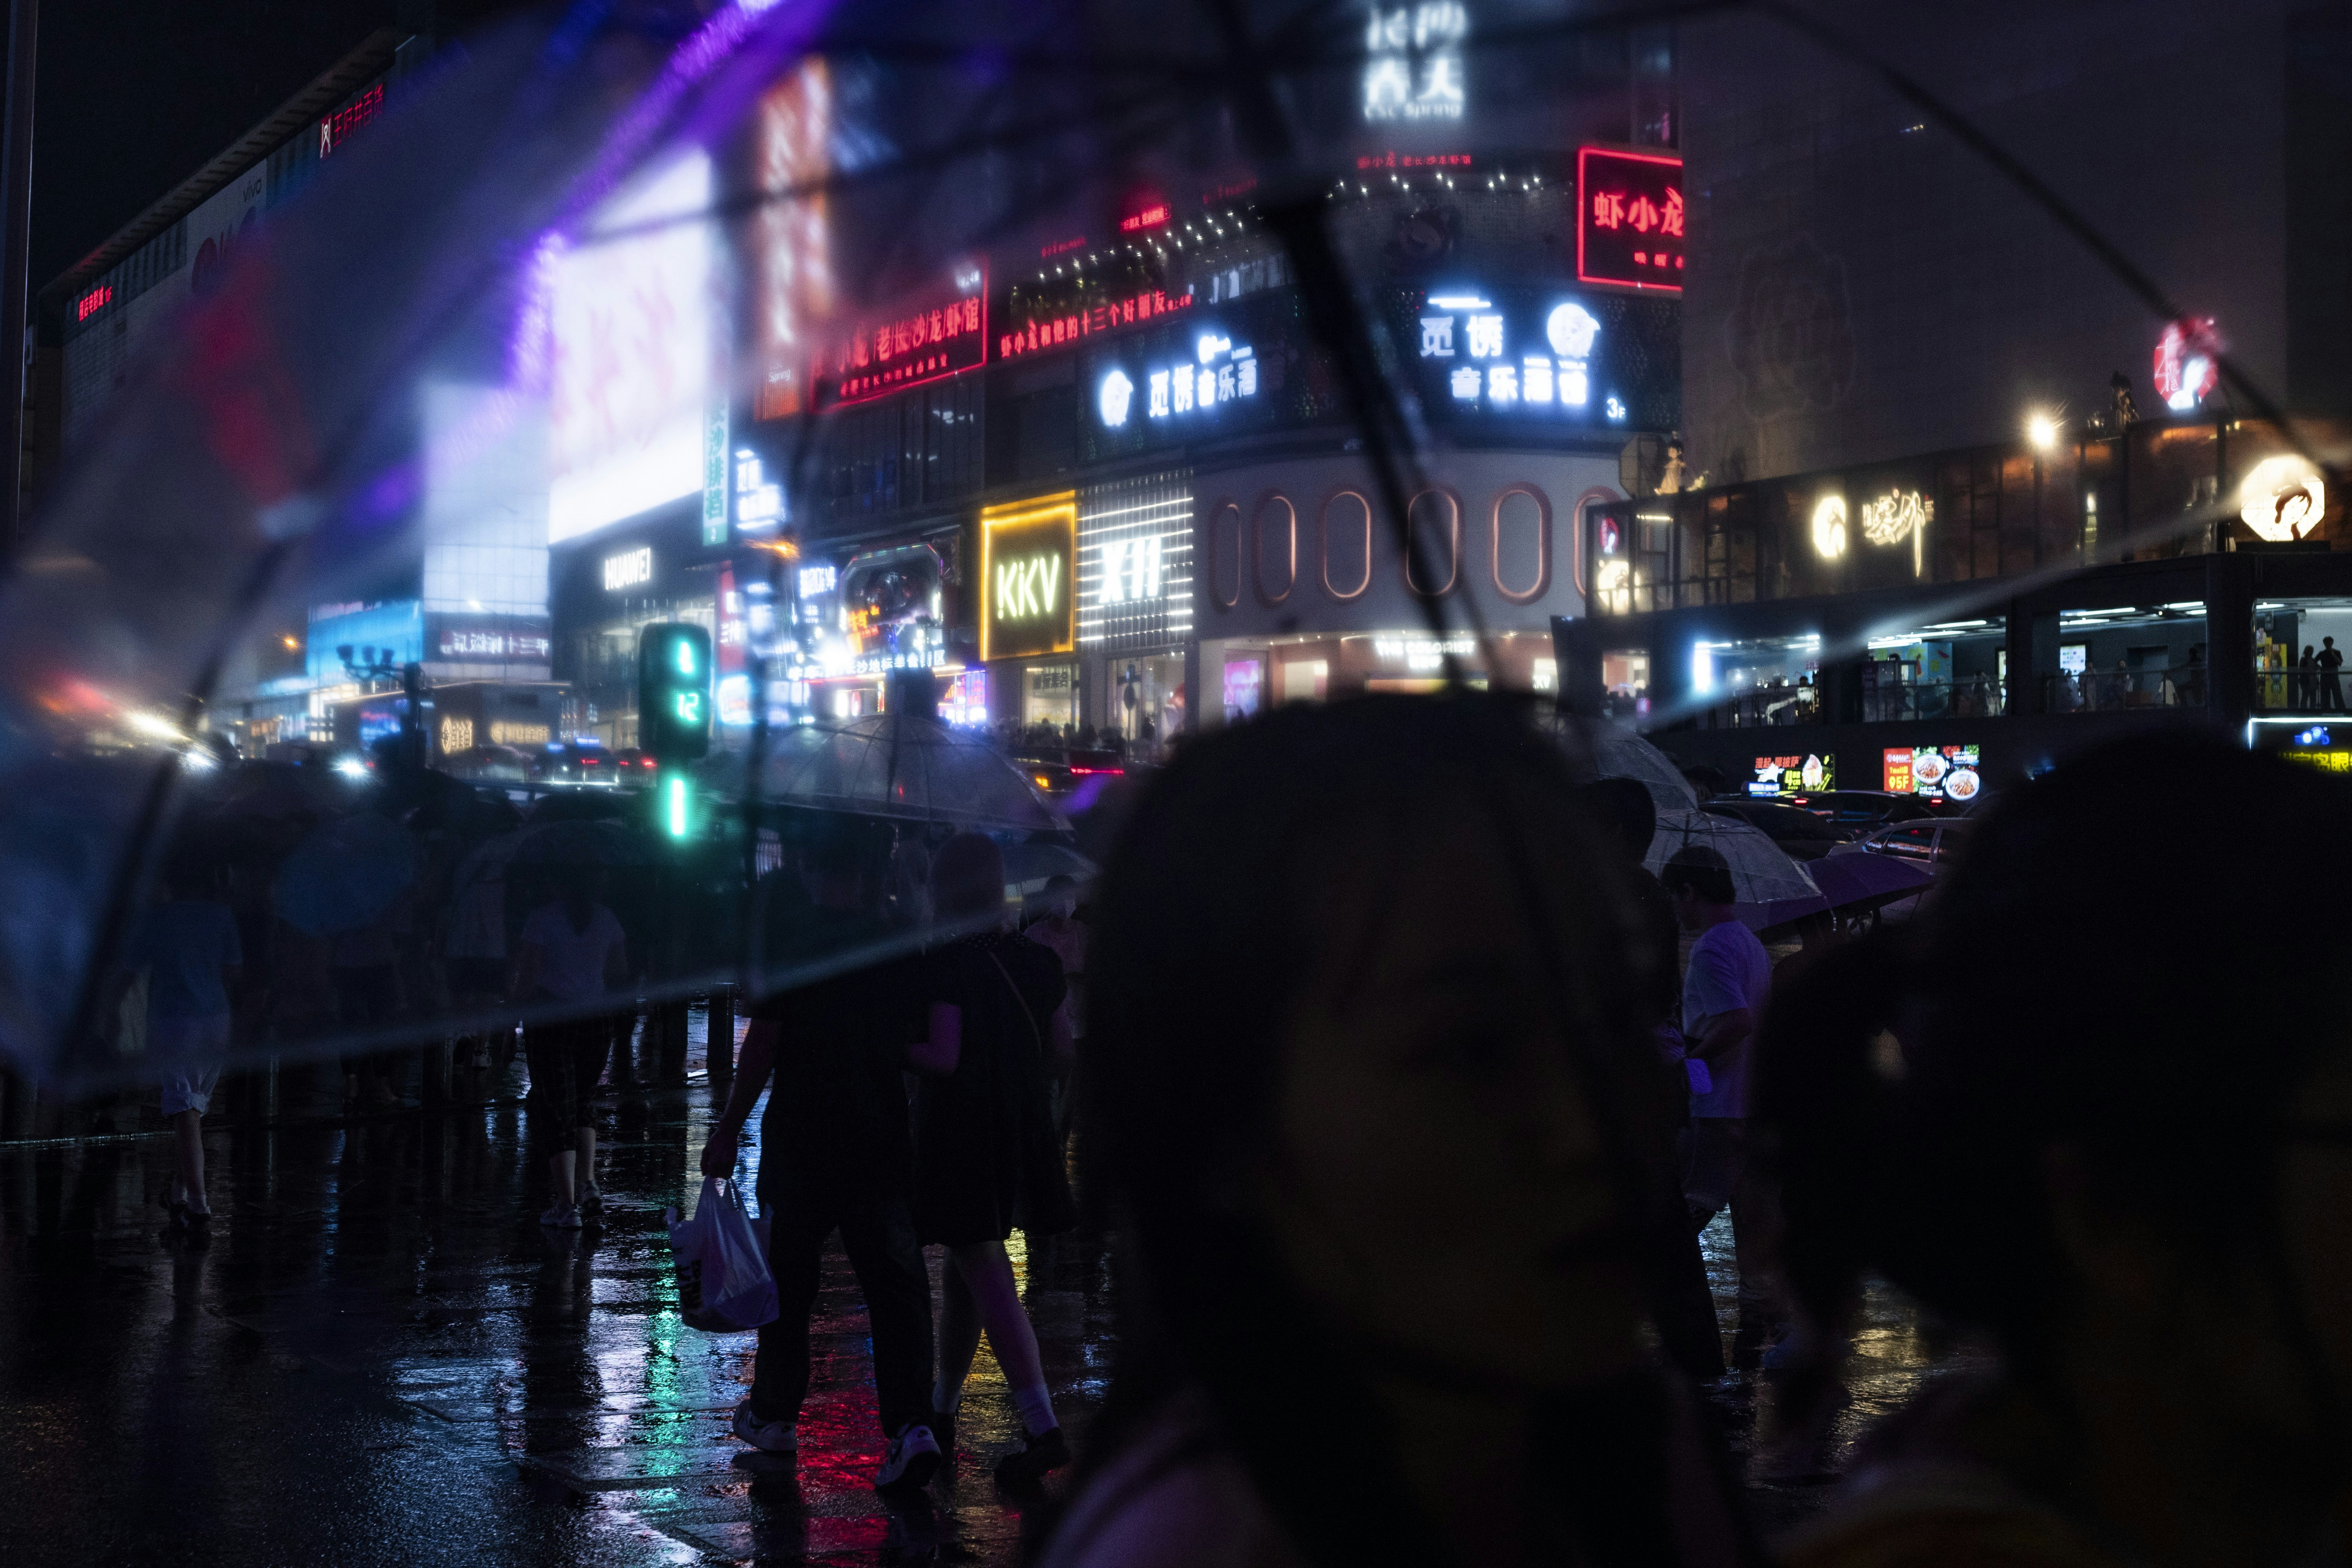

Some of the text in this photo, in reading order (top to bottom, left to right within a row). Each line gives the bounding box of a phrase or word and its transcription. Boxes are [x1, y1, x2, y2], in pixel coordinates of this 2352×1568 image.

[333, 84, 384, 147] 王府井百货
[243, 178, 262, 203] vivo
[1594, 186, 1683, 237] 虾小龙
[1607, 398, 1626, 418] 3F
[605, 547, 651, 590] HUAWEI
[997, 555, 1060, 620] KKV
[1375, 641, 1475, 656] THE COLORIST
[678, 693, 699, 721] 12
[1785, 770, 1793, 786] 4
